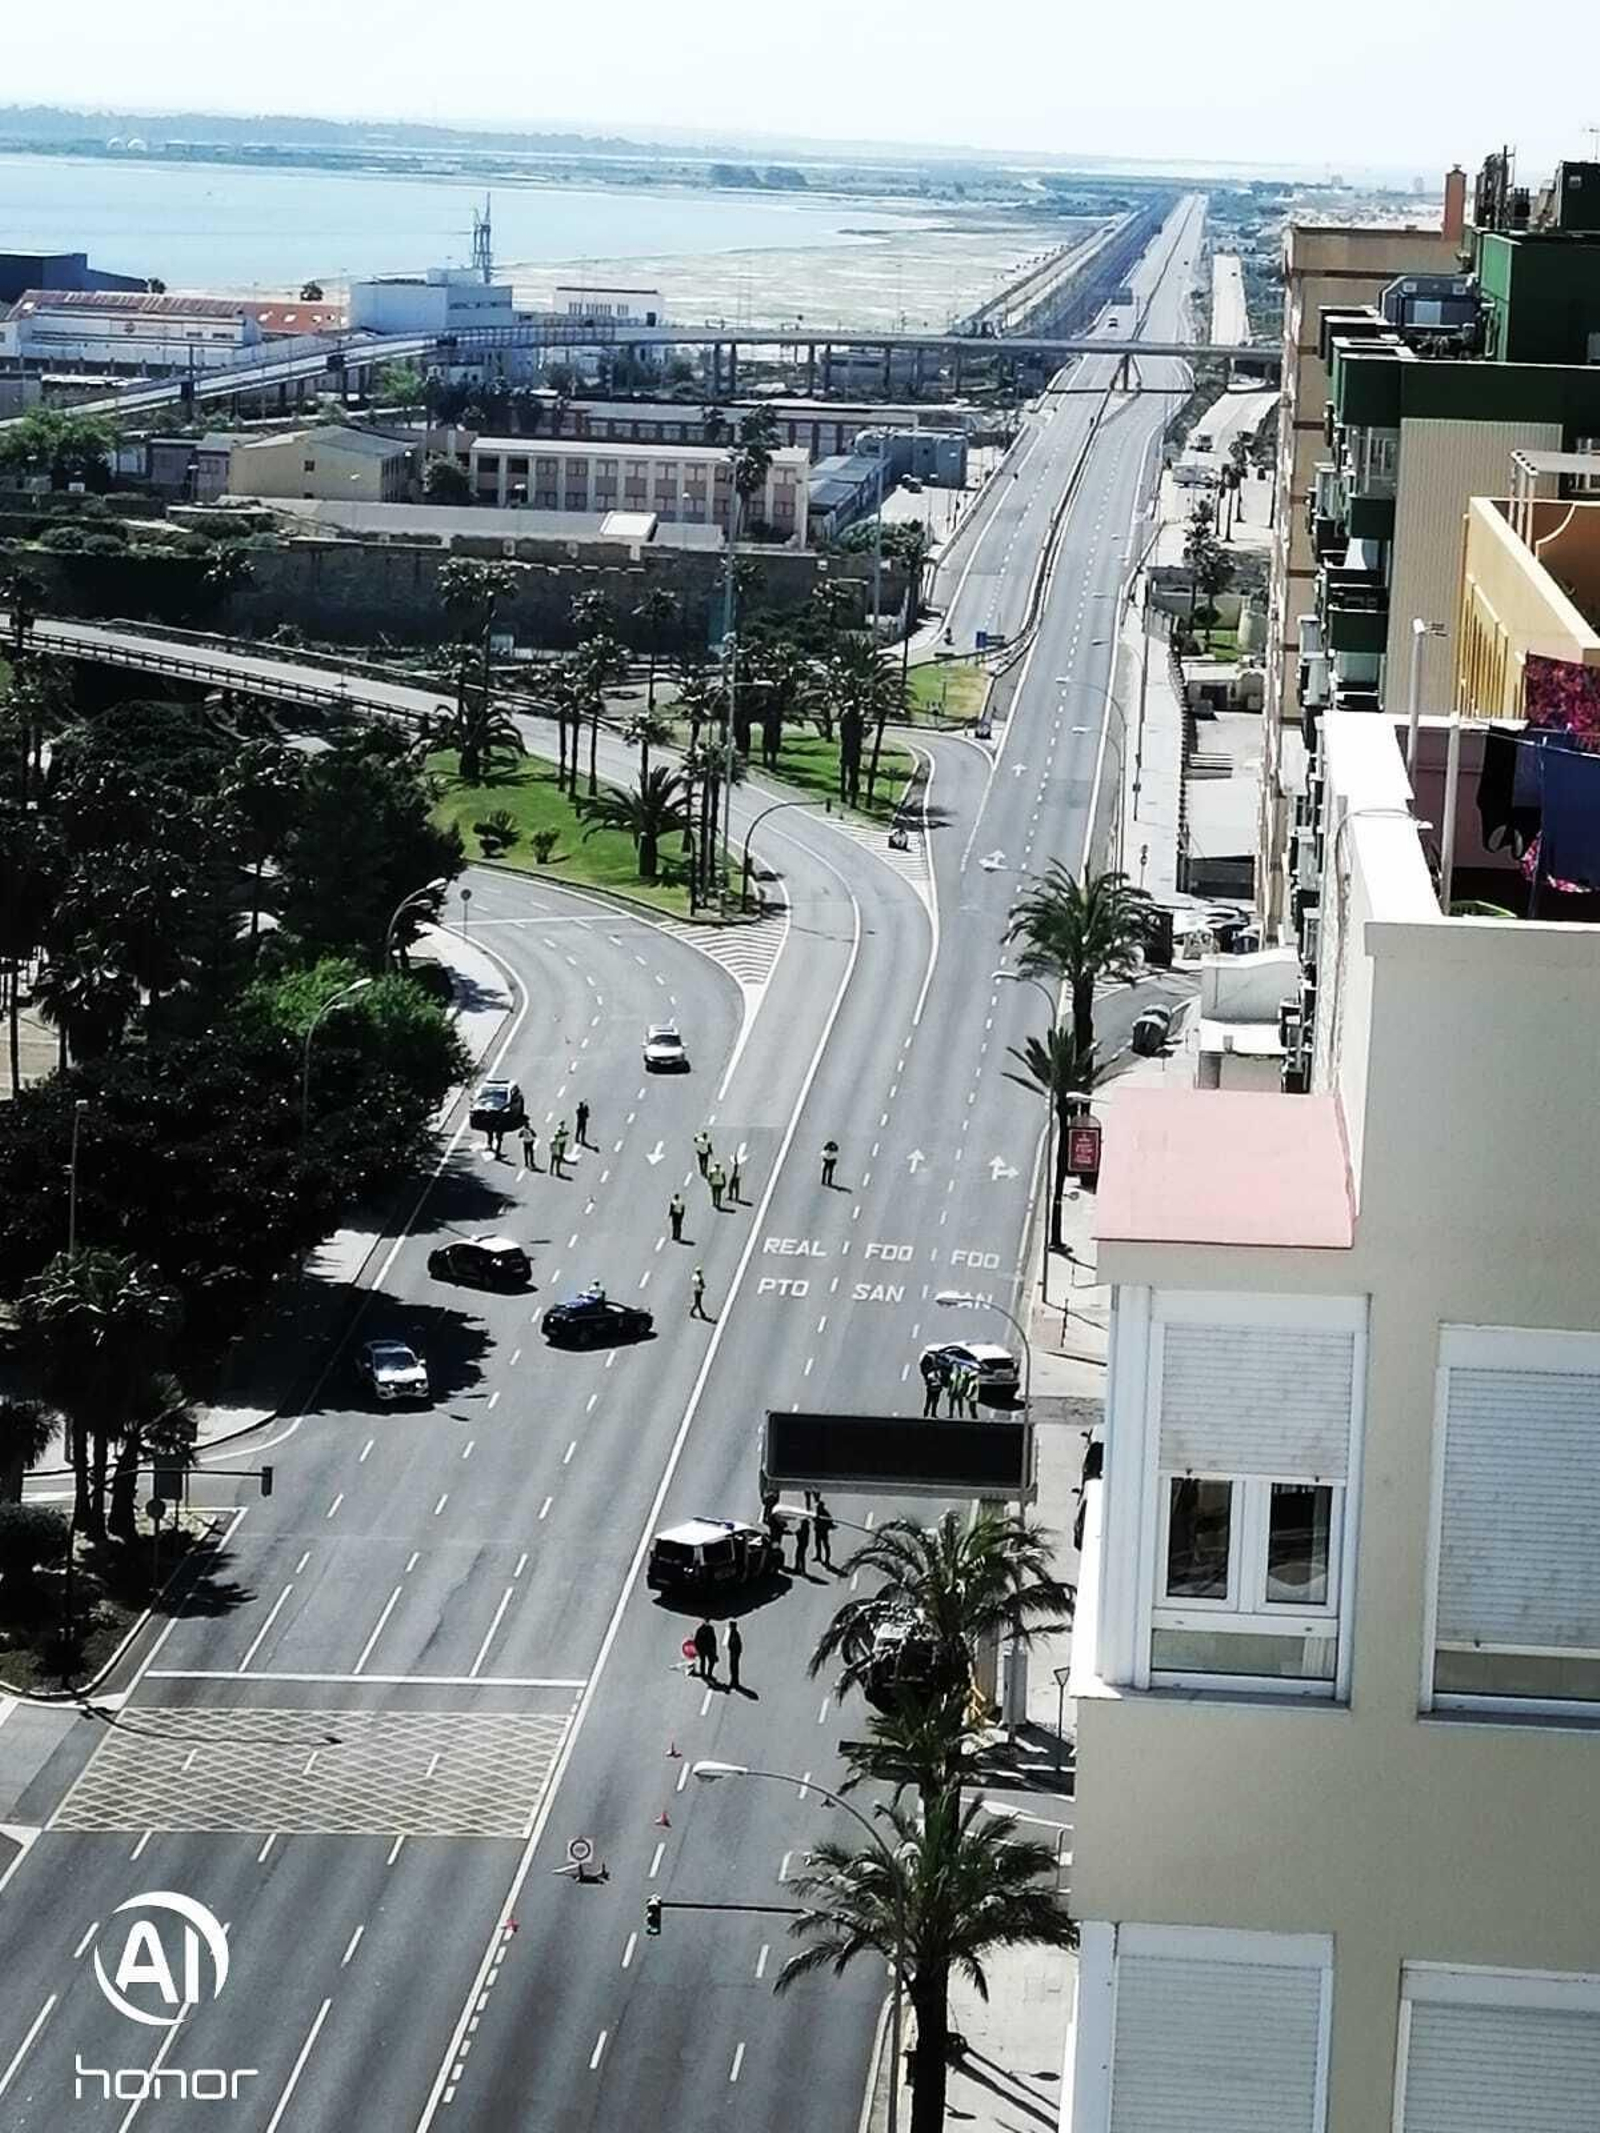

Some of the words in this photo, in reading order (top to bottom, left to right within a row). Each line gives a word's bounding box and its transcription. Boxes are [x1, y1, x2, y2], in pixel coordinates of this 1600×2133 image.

[763, 1238, 826, 1256] REAL
[757, 1277, 809, 1297] PTO
[852, 1283, 905, 1303] SAN
